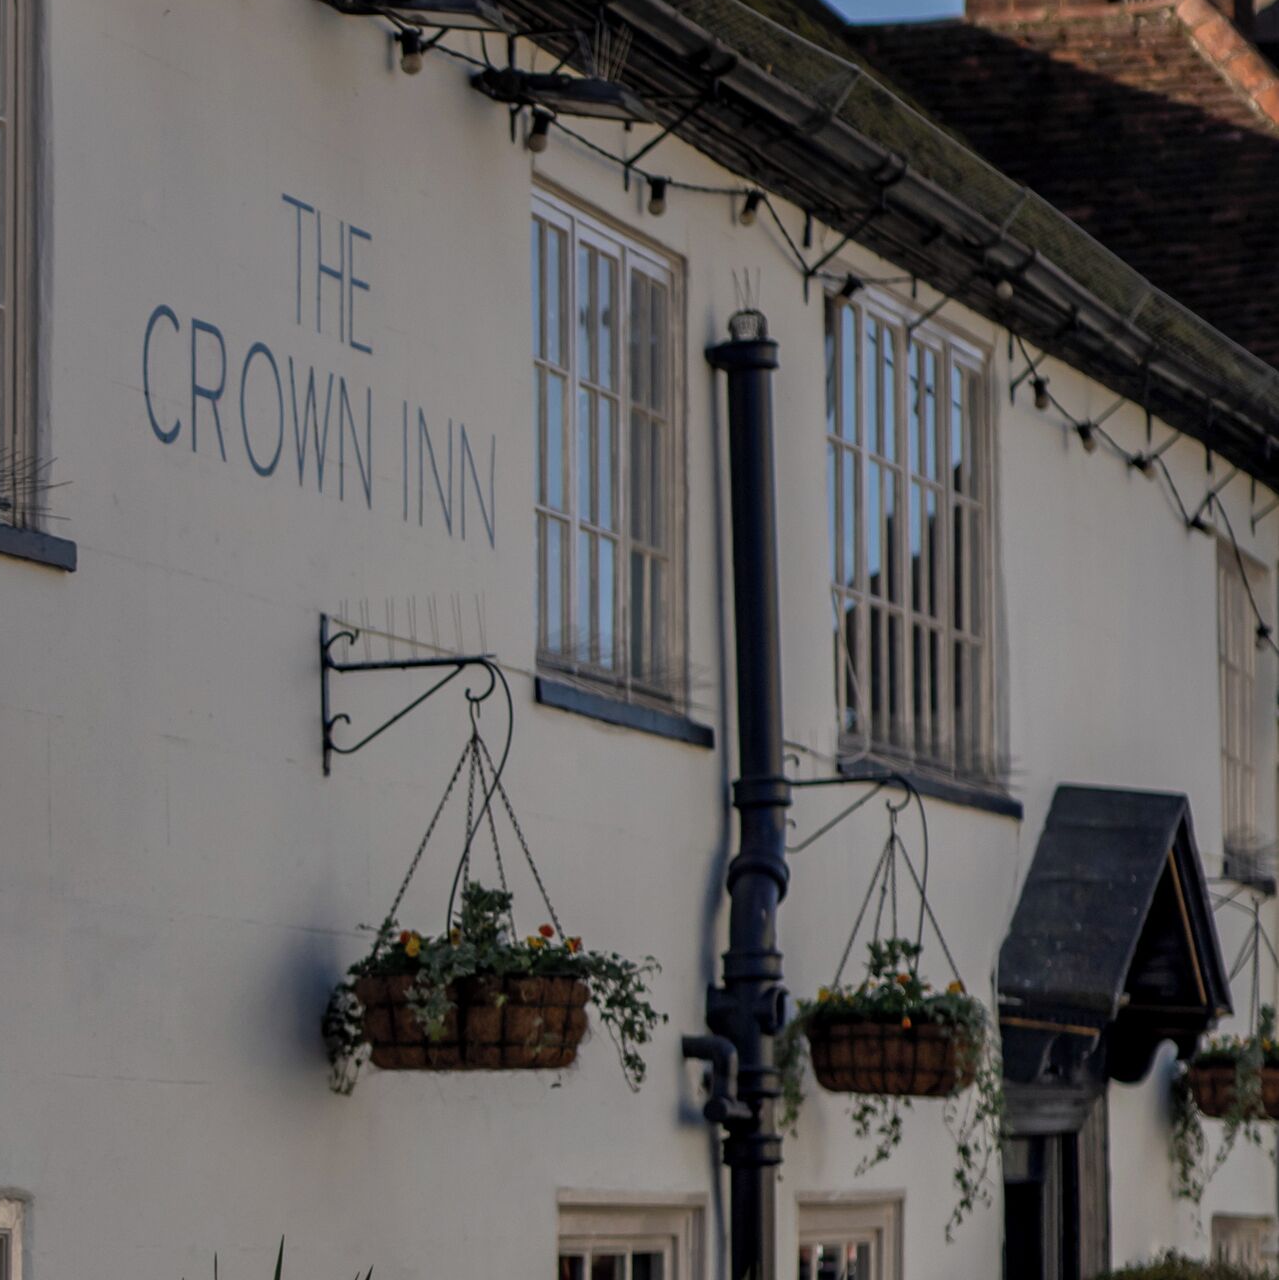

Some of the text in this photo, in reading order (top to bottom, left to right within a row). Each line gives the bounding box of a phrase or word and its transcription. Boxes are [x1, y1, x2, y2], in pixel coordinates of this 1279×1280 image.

[281, 192, 373, 355] THE
[143, 304, 496, 550] CROWN INN
